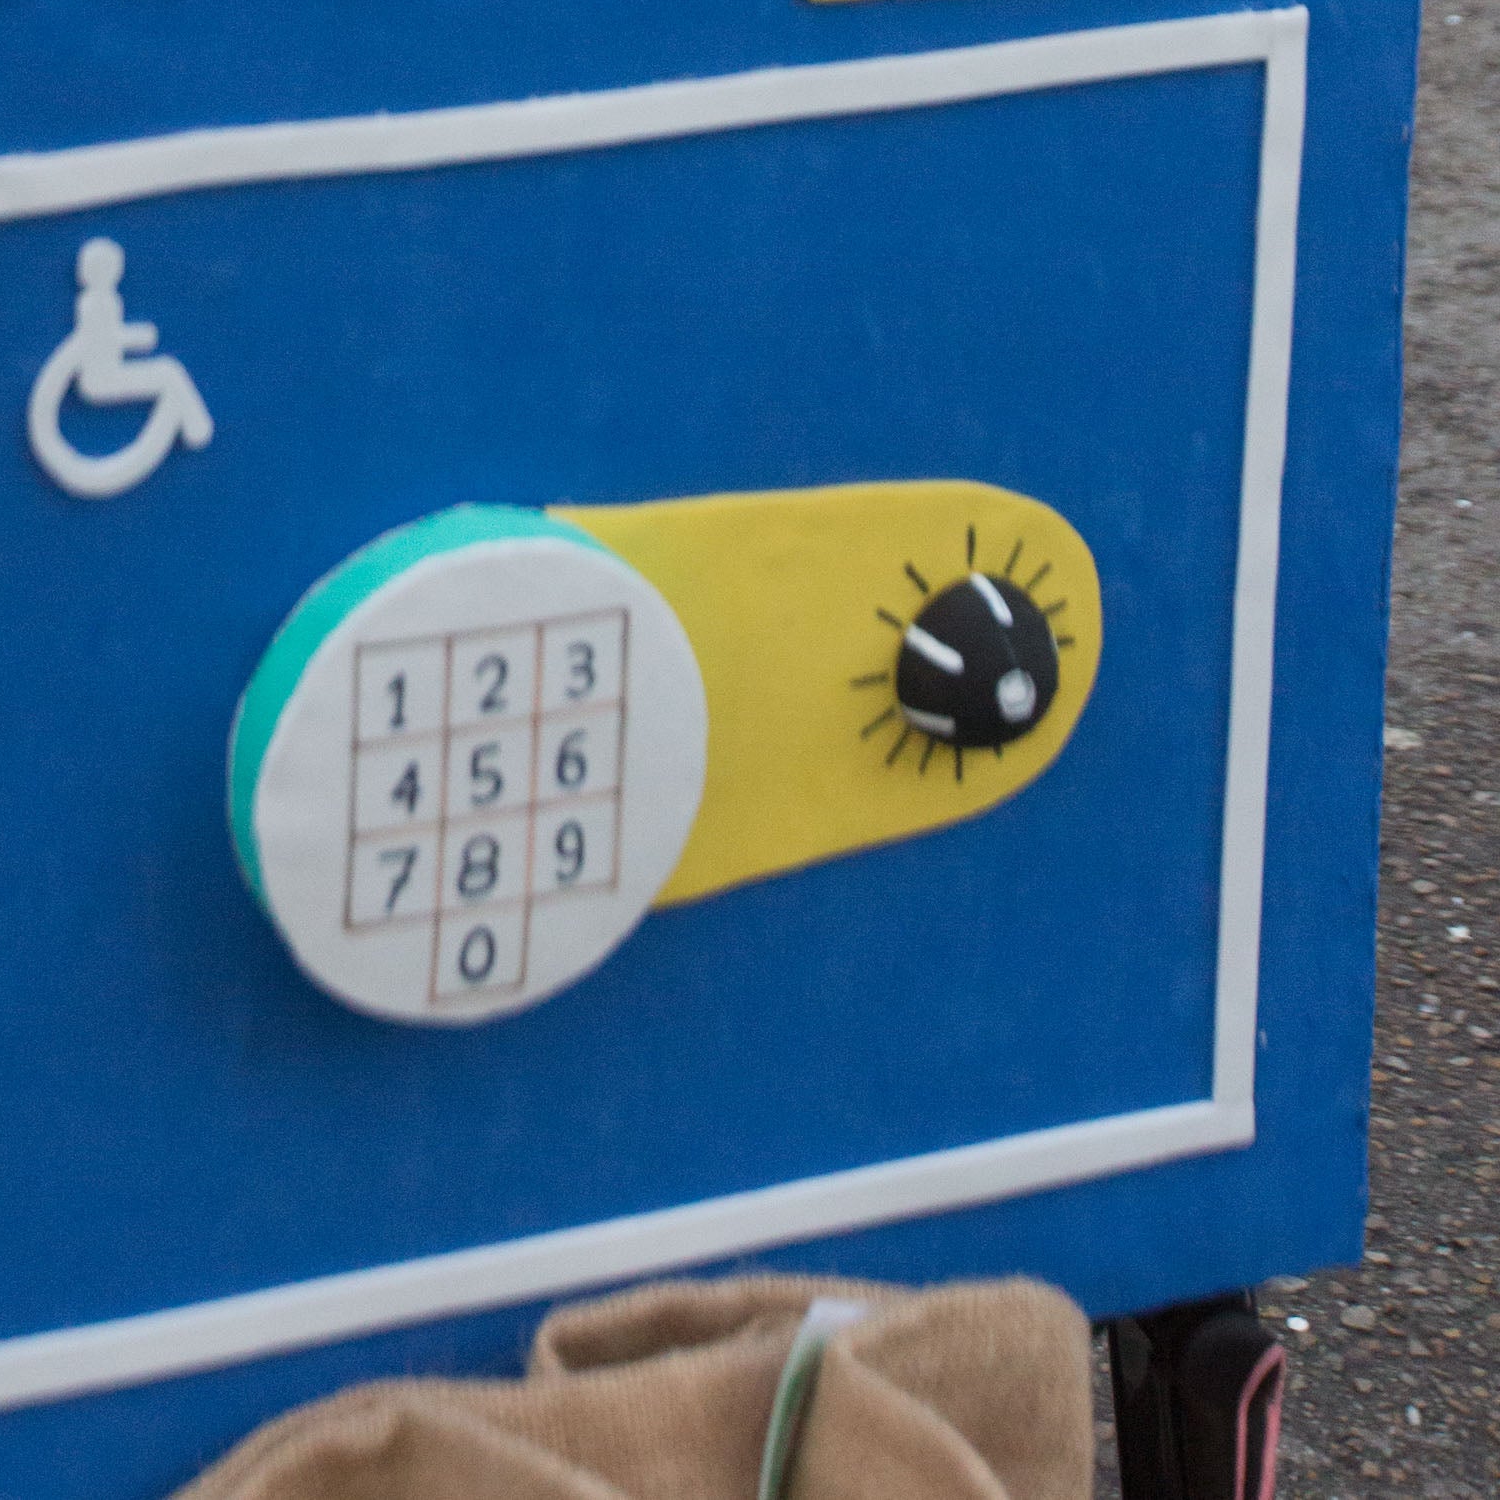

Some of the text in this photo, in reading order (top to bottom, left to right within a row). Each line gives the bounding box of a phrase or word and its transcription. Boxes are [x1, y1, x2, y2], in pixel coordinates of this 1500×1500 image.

[386, 640, 597, 730] 1 2 3
[390, 727, 588, 815] 4 5 6
[378, 818, 586, 914] 7 8 9
[457, 924, 496, 985] 0
